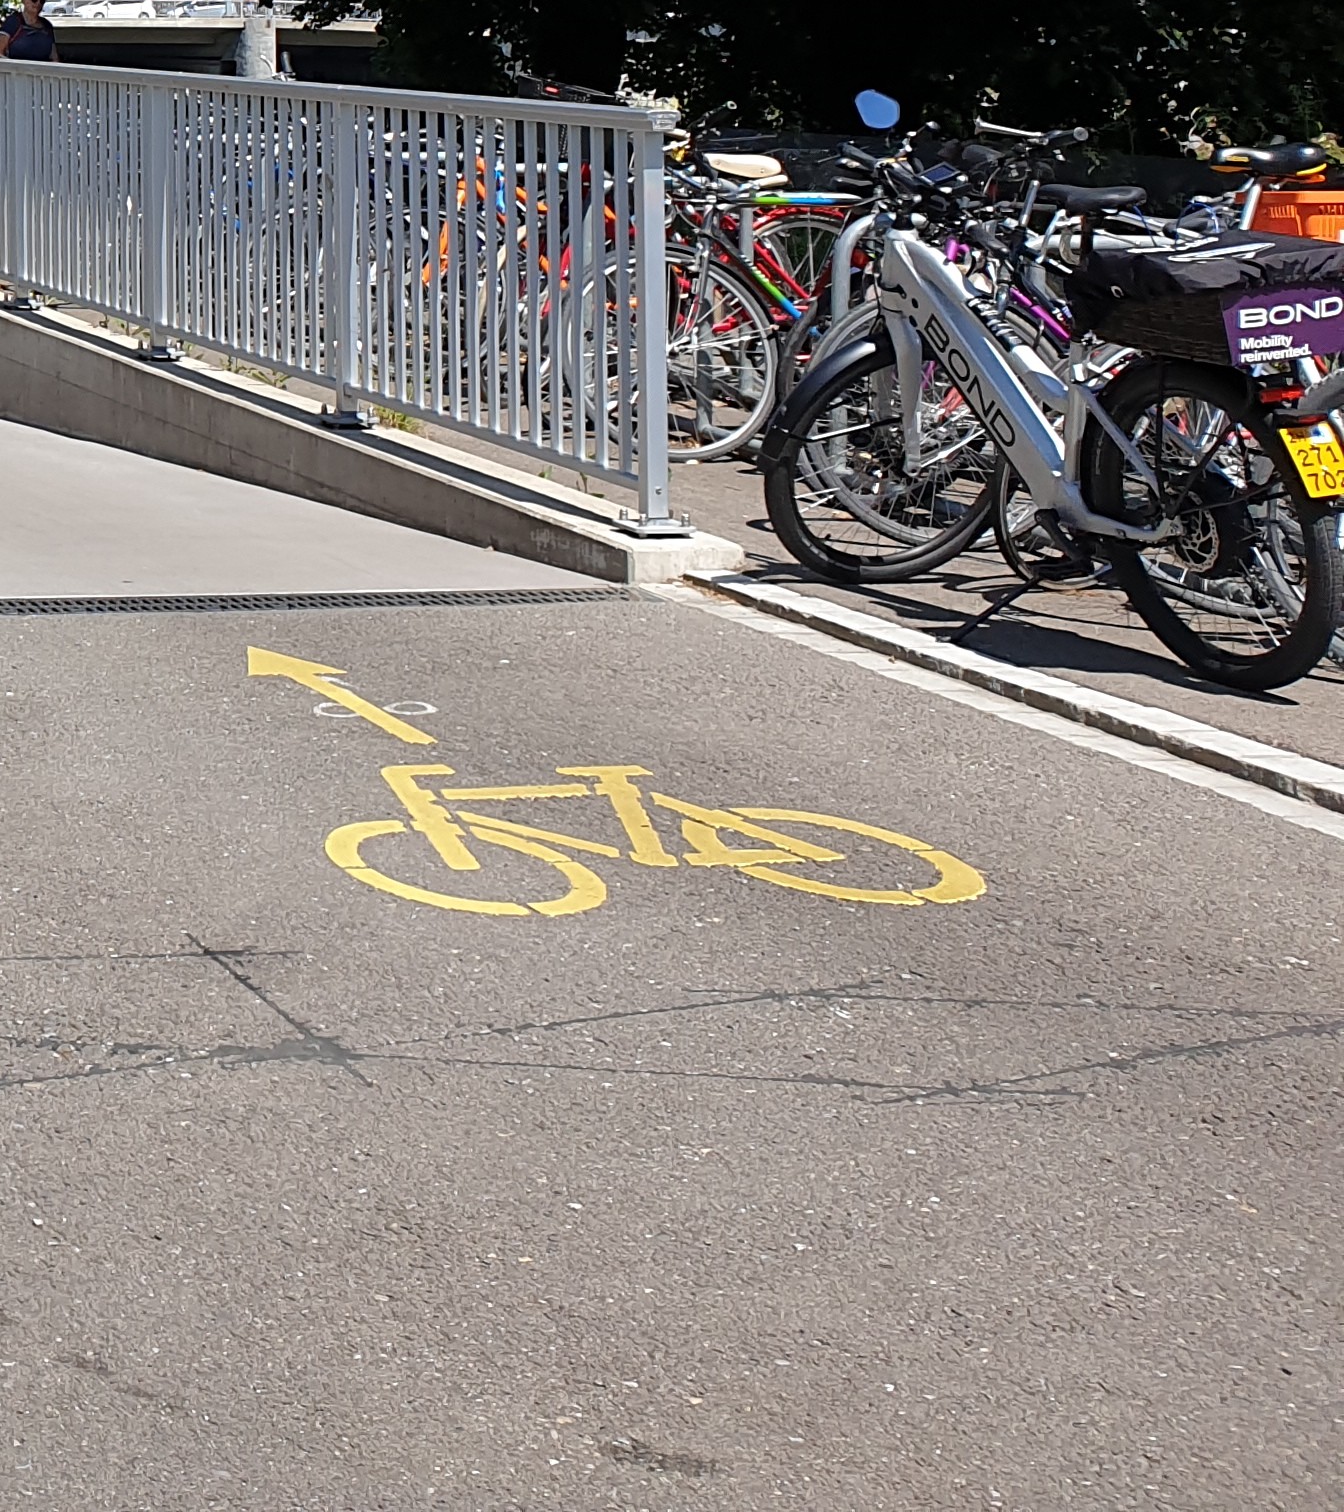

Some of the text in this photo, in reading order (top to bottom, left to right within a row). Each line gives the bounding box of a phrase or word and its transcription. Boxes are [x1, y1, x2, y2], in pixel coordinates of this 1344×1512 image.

[1238, 296, 1344, 329] BOND
[1240, 334, 1293, 350] Mobility
[1240, 344, 1312, 364] reinvented.
[924, 313, 1016, 447] BOND
[1297, 445, 1340, 467] 271
